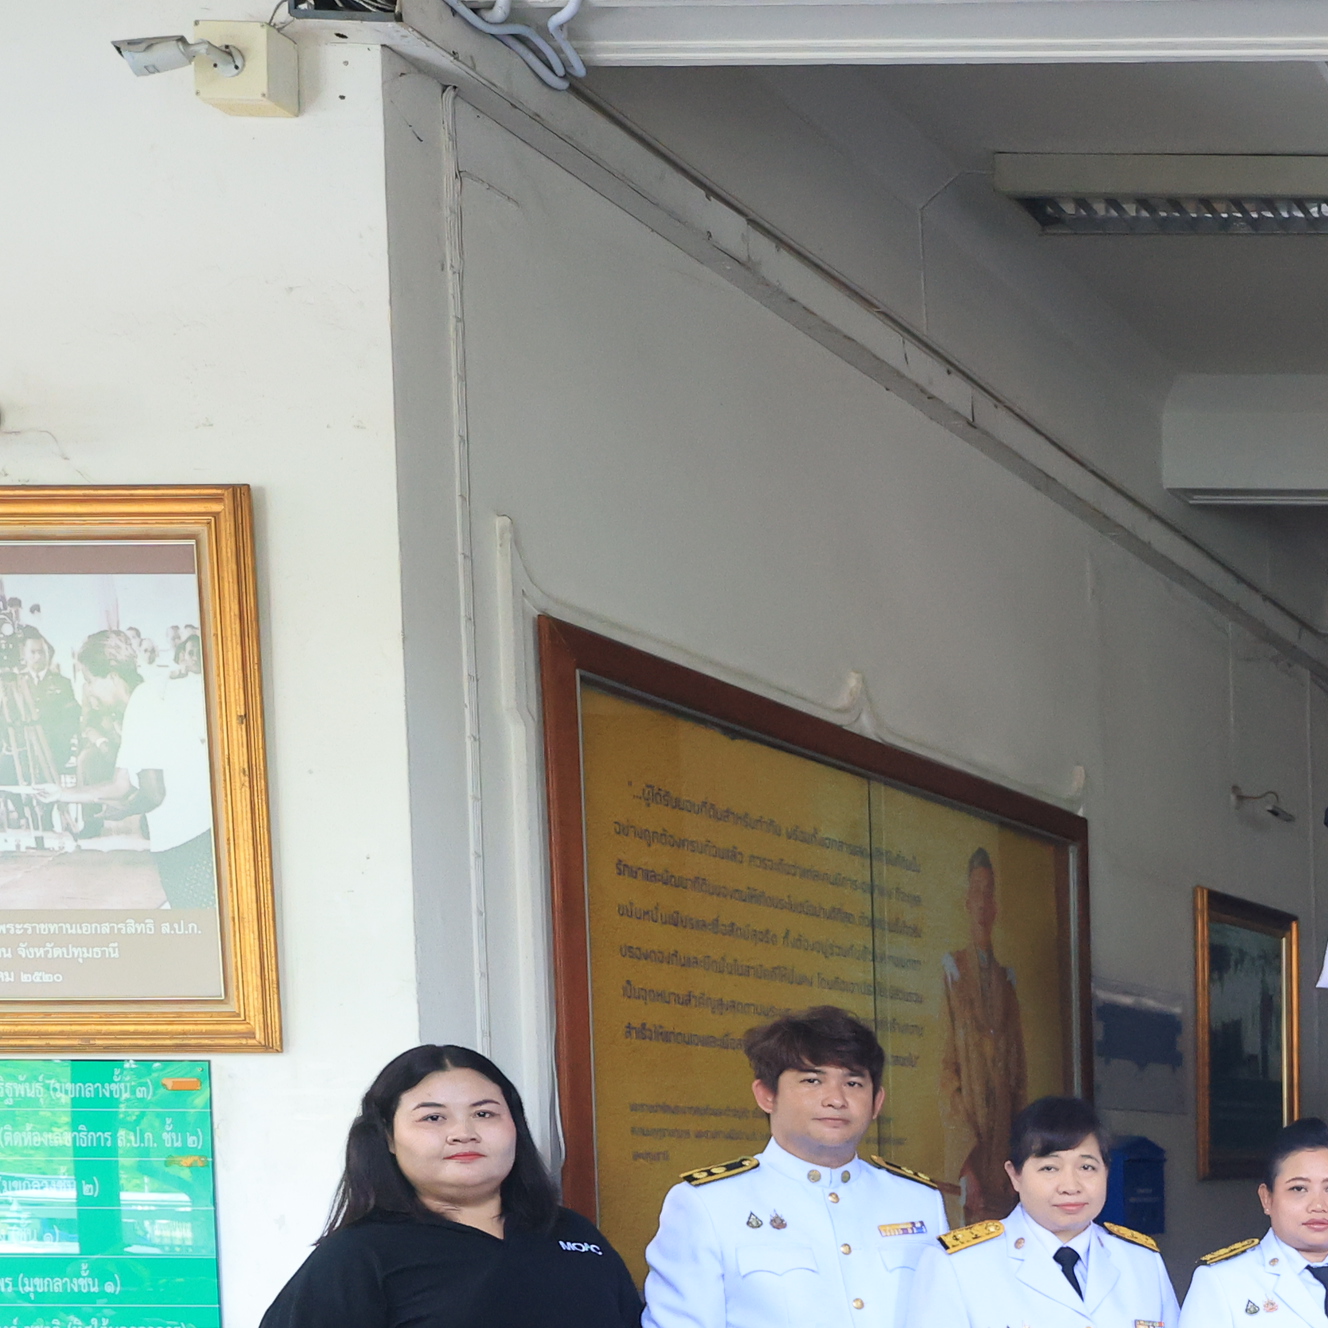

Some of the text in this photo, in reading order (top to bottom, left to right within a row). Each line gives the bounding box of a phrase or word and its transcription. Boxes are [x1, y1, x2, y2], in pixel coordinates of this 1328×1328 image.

[160, 919, 203, 935] ส.ป.ก.
[17, 941, 119, 964] จังหวัดปทุมธานี
[20, 970, 63, 983] ๒๕๒๐
[117, 1127, 157, 1148] ส.ป.ก.
[162, 1117, 182, 1148] ชั้น
[18, 1262, 99, 1300] (มุขกลางชั้น
[104, 1273, 121, 1294] ๑)
